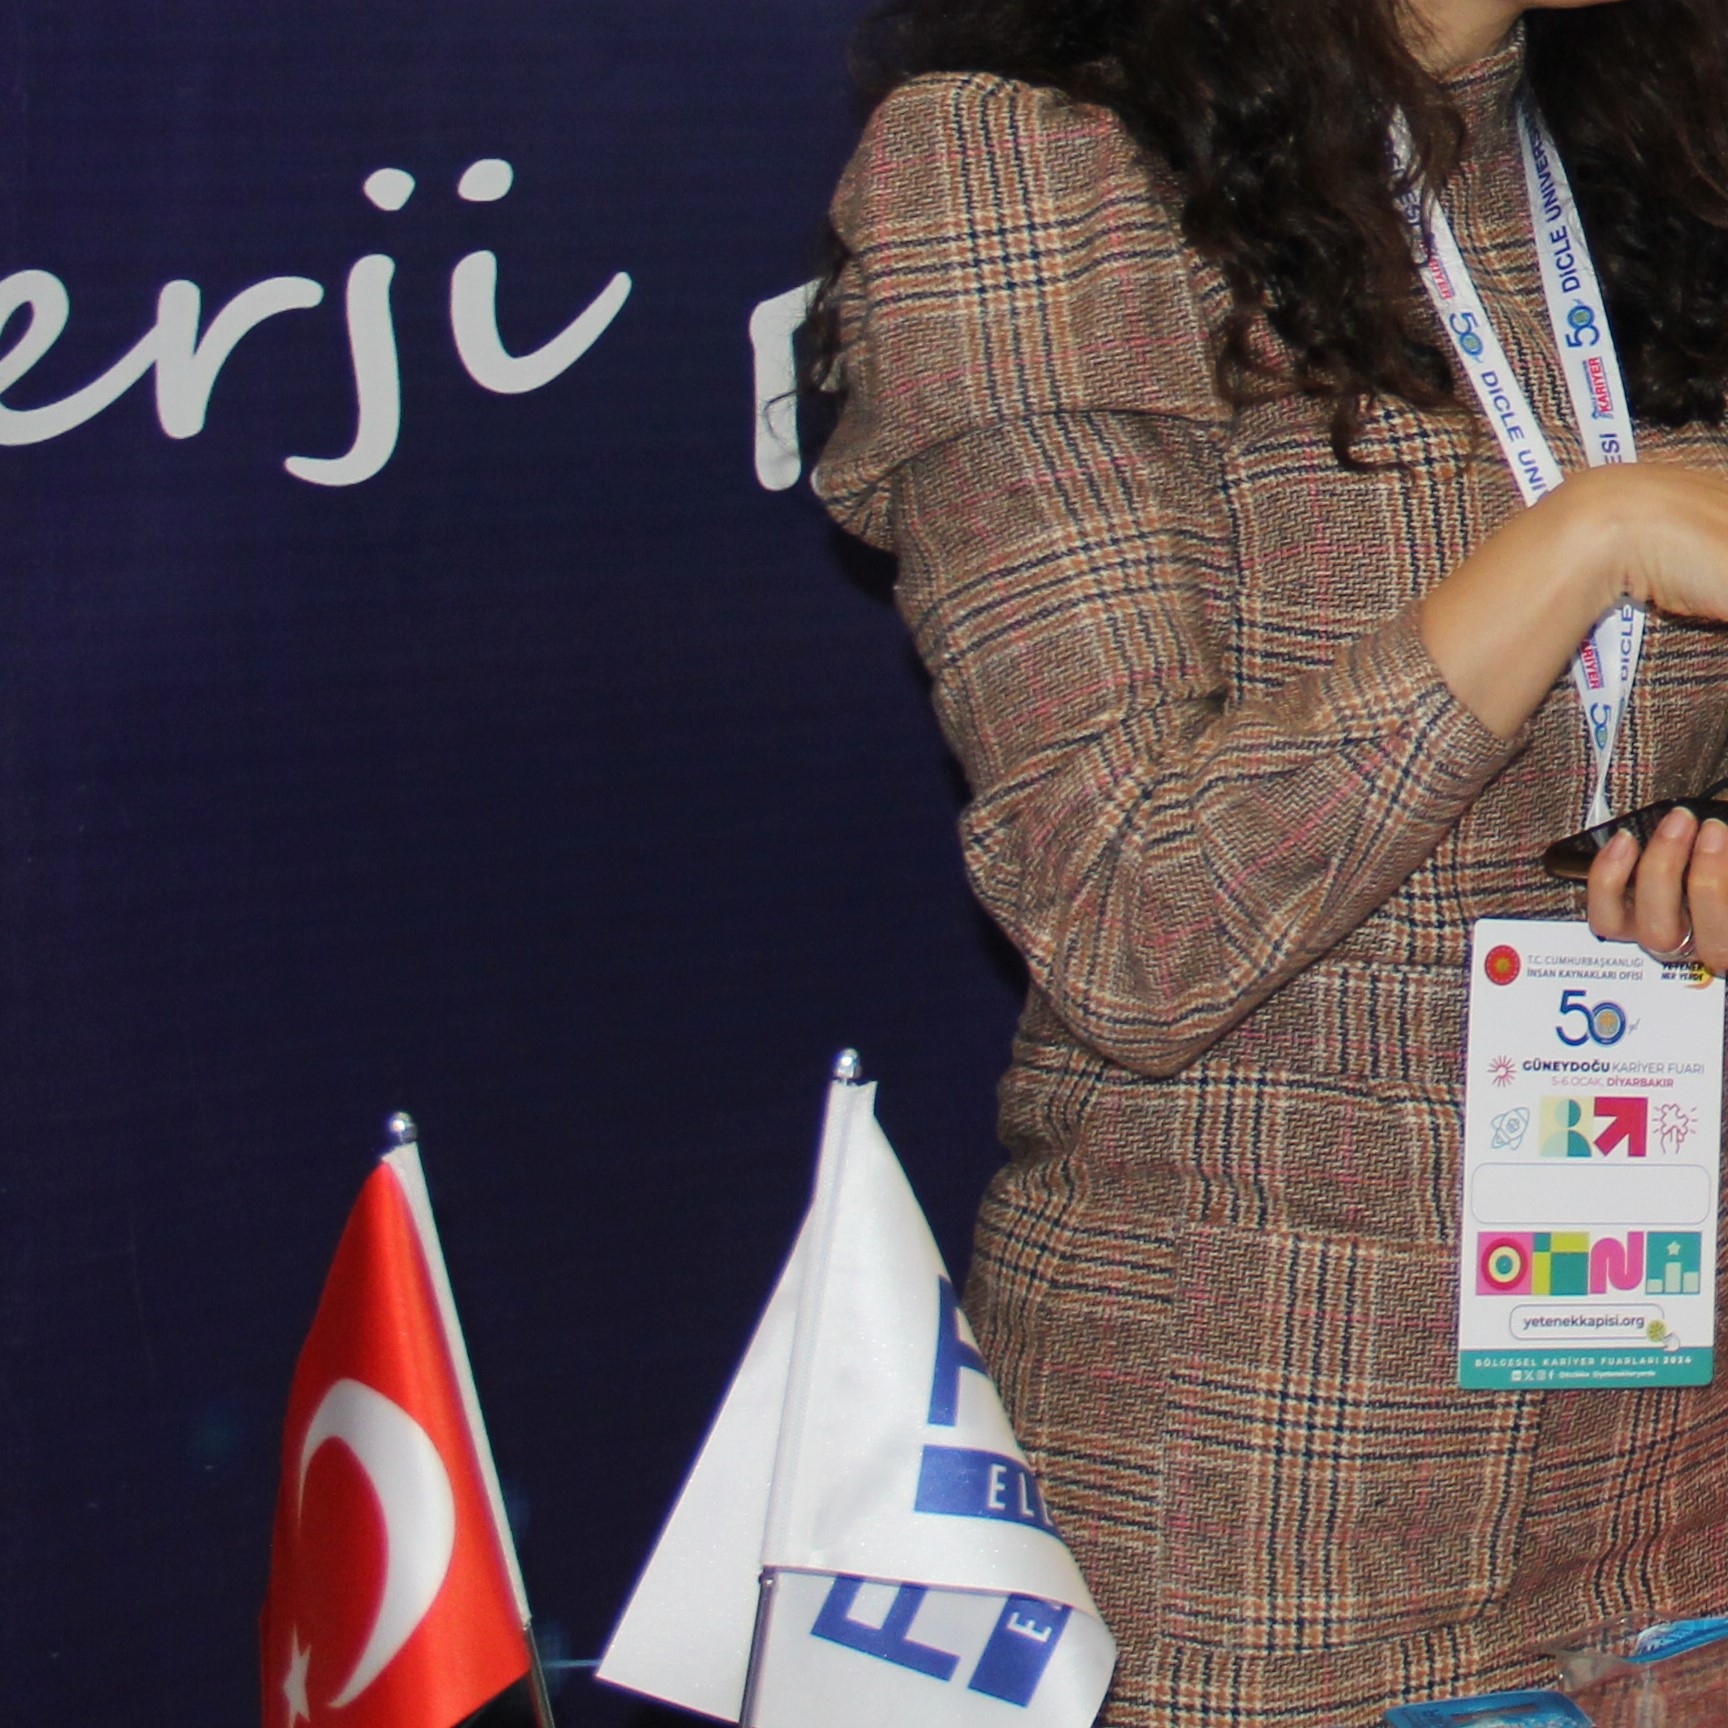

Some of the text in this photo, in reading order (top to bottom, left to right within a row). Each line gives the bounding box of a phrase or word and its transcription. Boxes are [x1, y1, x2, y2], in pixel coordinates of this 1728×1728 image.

[1556, 989, 1626, 1047] 50
[1522, 1058, 1610, 1073] GÜNEYDOĞU
[1667, 1063, 1705, 1075] FUARI
[1606, 1075, 1674, 1087] DİYARBAKIR
[1523, 1315, 1645, 1331] yetenekkapisi.org
